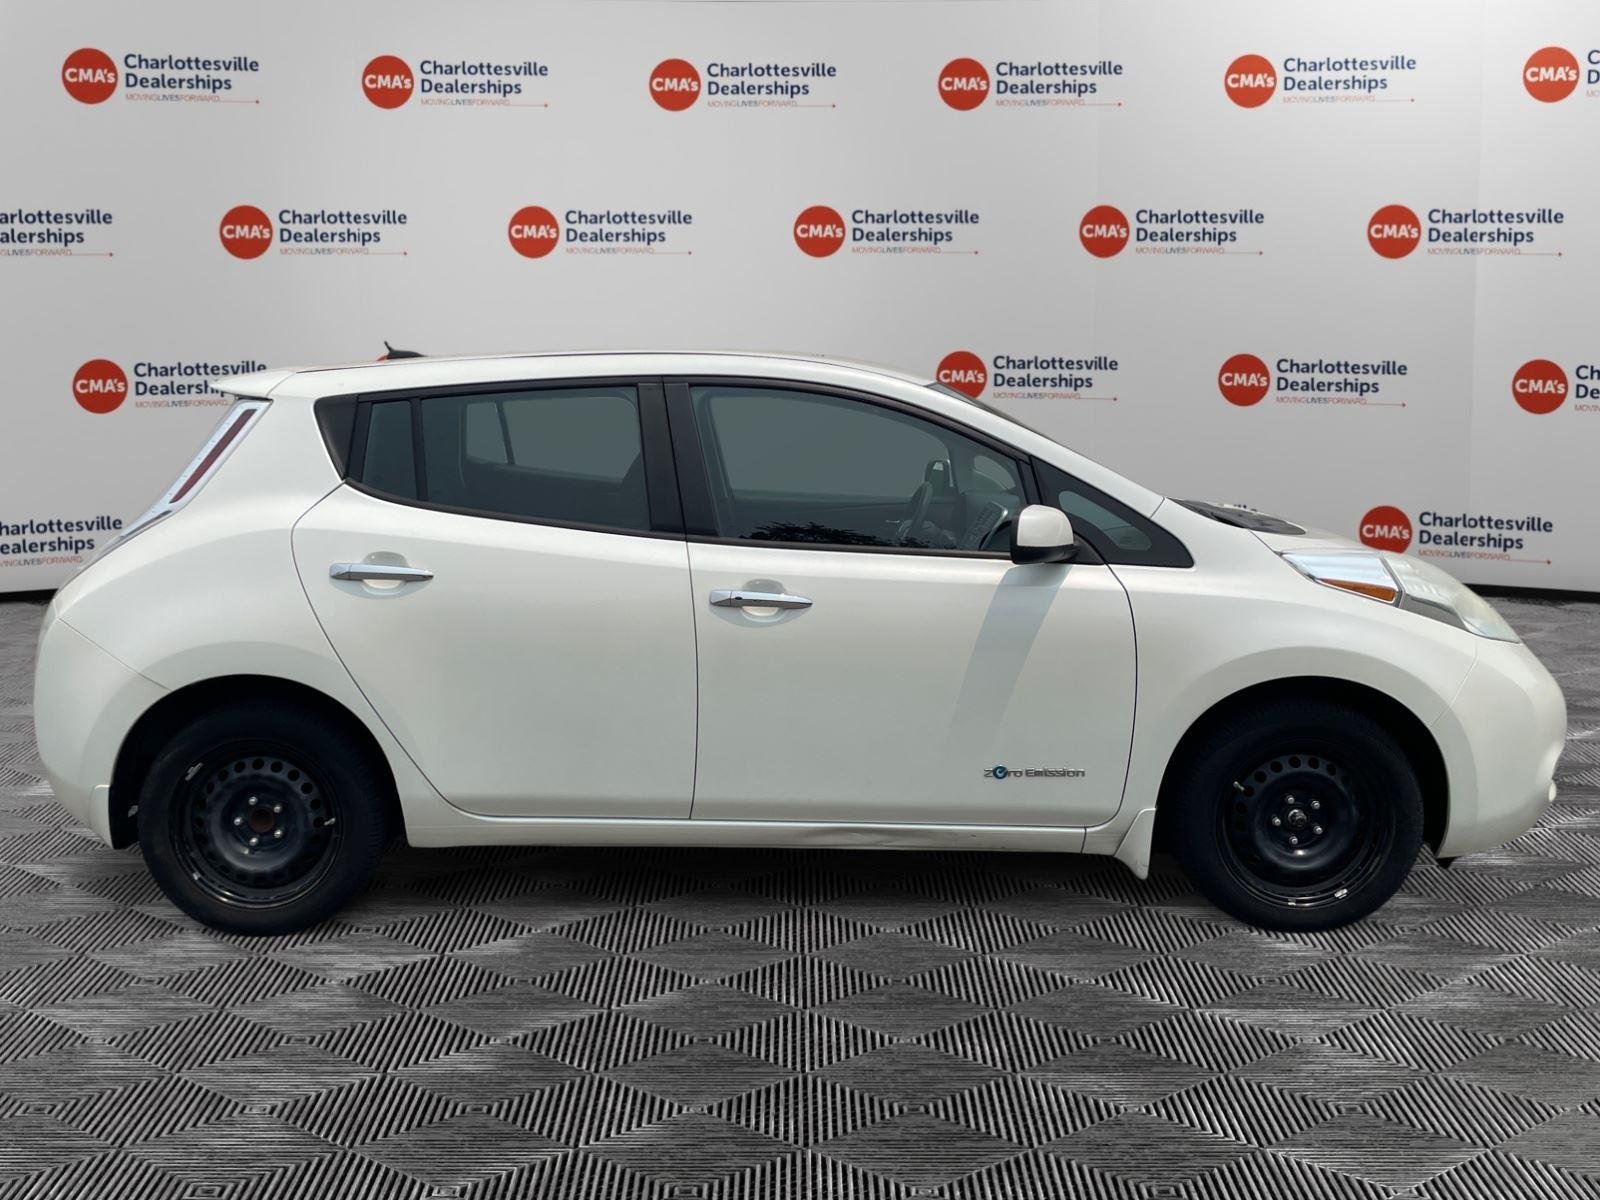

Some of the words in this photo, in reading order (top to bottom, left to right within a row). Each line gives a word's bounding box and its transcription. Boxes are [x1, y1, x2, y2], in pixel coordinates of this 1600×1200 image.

[124, 54, 259, 72] Charlottesville
[420, 60, 548, 76] Charlottesville
[707, 63, 836, 77] Charlottesville
[996, 61, 1122, 76] Charlottesville
[1284, 56, 1416, 72] Charlottesville
[63, 67, 116, 84] CMA's
[364, 74, 412, 89] CMA's
[1226, 72, 1274, 89] CMA's
[1525, 66, 1578, 82] CMA's
[125, 73, 232, 93] Dealerships
[421, 78, 522, 97] Dealerships
[652, 77, 699, 92] CMA's
[708, 81, 809, 99] Dealerships
[939, 77, 988, 91] CMA's
[997, 80, 1097, 97] Dealerships
[1284, 75, 1387, 93] Dealerships
[279, 210, 407, 224] Charlottesville
[565, 210, 692, 224] Charlottesville
[852, 210, 979, 224] Charlottesville
[1136, 209, 1264, 224] Charlottesville
[1428, 209, 1564, 224] Charlottesville
[223, 224, 271, 239] CMA's
[280, 228, 380, 246] Dealerships
[510, 224, 557, 239] CMA's
[566, 228, 666, 246] Dealerships
[795, 224, 844, 238] CMA's
[853, 228, 952, 246] Dealerships
[1081, 224, 1127, 238] CMA's
[1136, 227, 1236, 246] Dealerships
[1370, 223, 1419, 239] CMA's
[1428, 227, 1534, 246] Dealerships
[134, 360, 266, 377] Charlottesville
[993, 356, 1118, 370] Charlottesville
[1277, 359, 1407, 375] Charlottesville
[939, 369, 985, 383] CMA's
[994, 373, 1092, 391] Dealerships
[1220, 372, 1268, 387] CMA's
[75, 378, 126, 394] CMA's
[1277, 377, 1379, 396] Dealerships
[1515, 379, 1566, 394] CMA's
[1419, 512, 1553, 532] Charlottesville
[1362, 524, 1410, 540] CMA's
[1419, 529, 1524, 551] Dealerships
[1025, 767, 1086, 778] Emission
